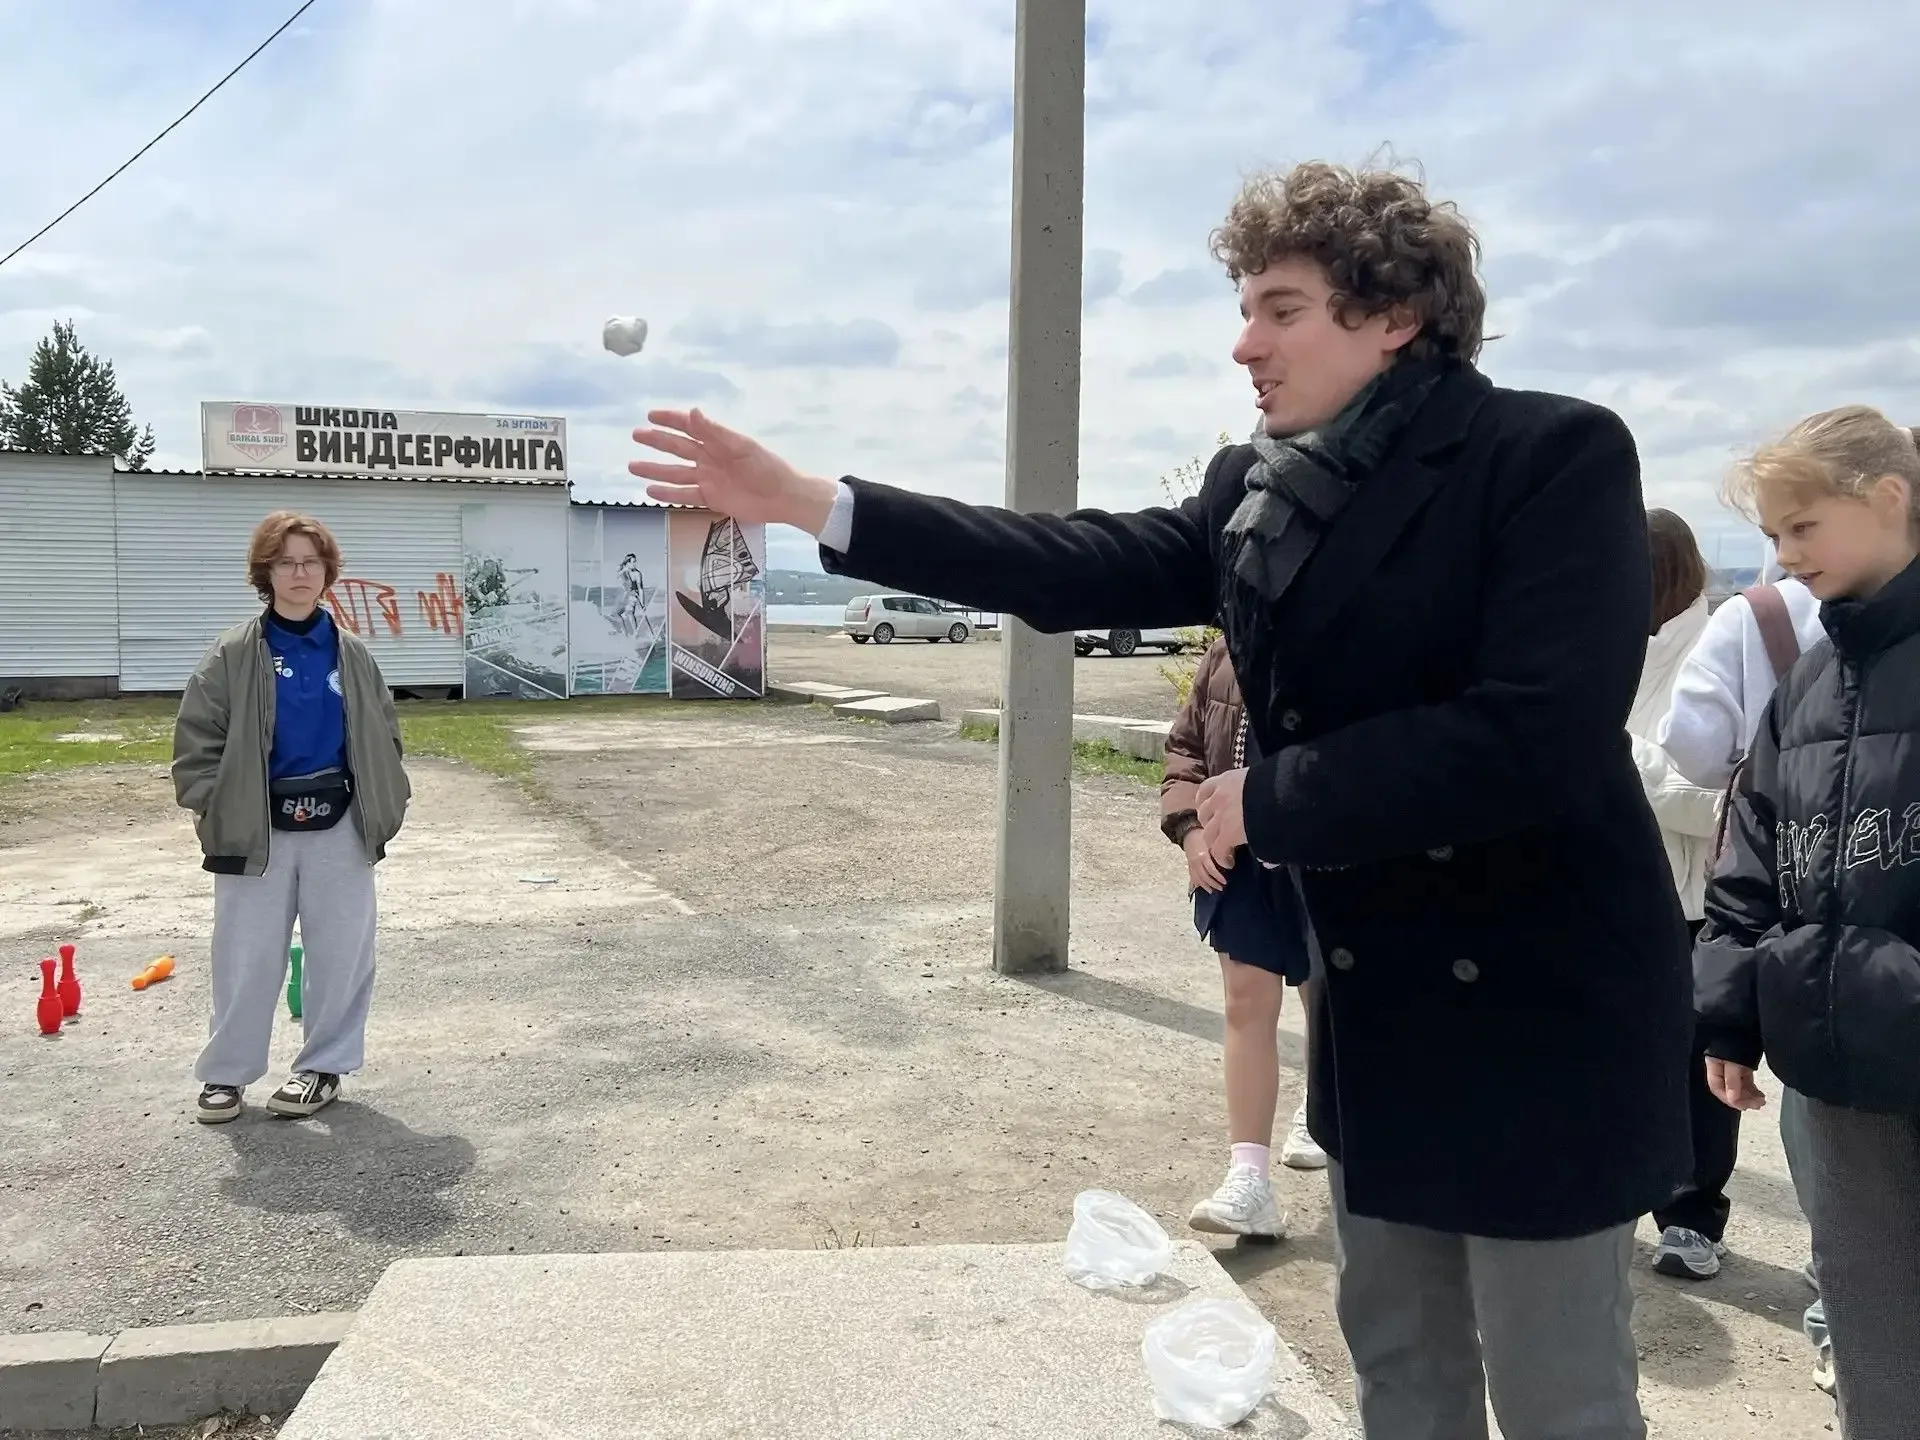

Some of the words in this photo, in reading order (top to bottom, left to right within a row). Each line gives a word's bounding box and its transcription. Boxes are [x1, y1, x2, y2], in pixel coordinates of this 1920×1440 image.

[295, 406, 398, 430] ШКОЛА
[512, 419, 548, 430] УГЛОМ
[229, 433, 261, 443] BAIKAL
[263, 435, 285, 444] SURF
[295, 429, 564, 471] ВИНДСЕРФИНГА
[673, 649, 736, 695] WINSURFING
